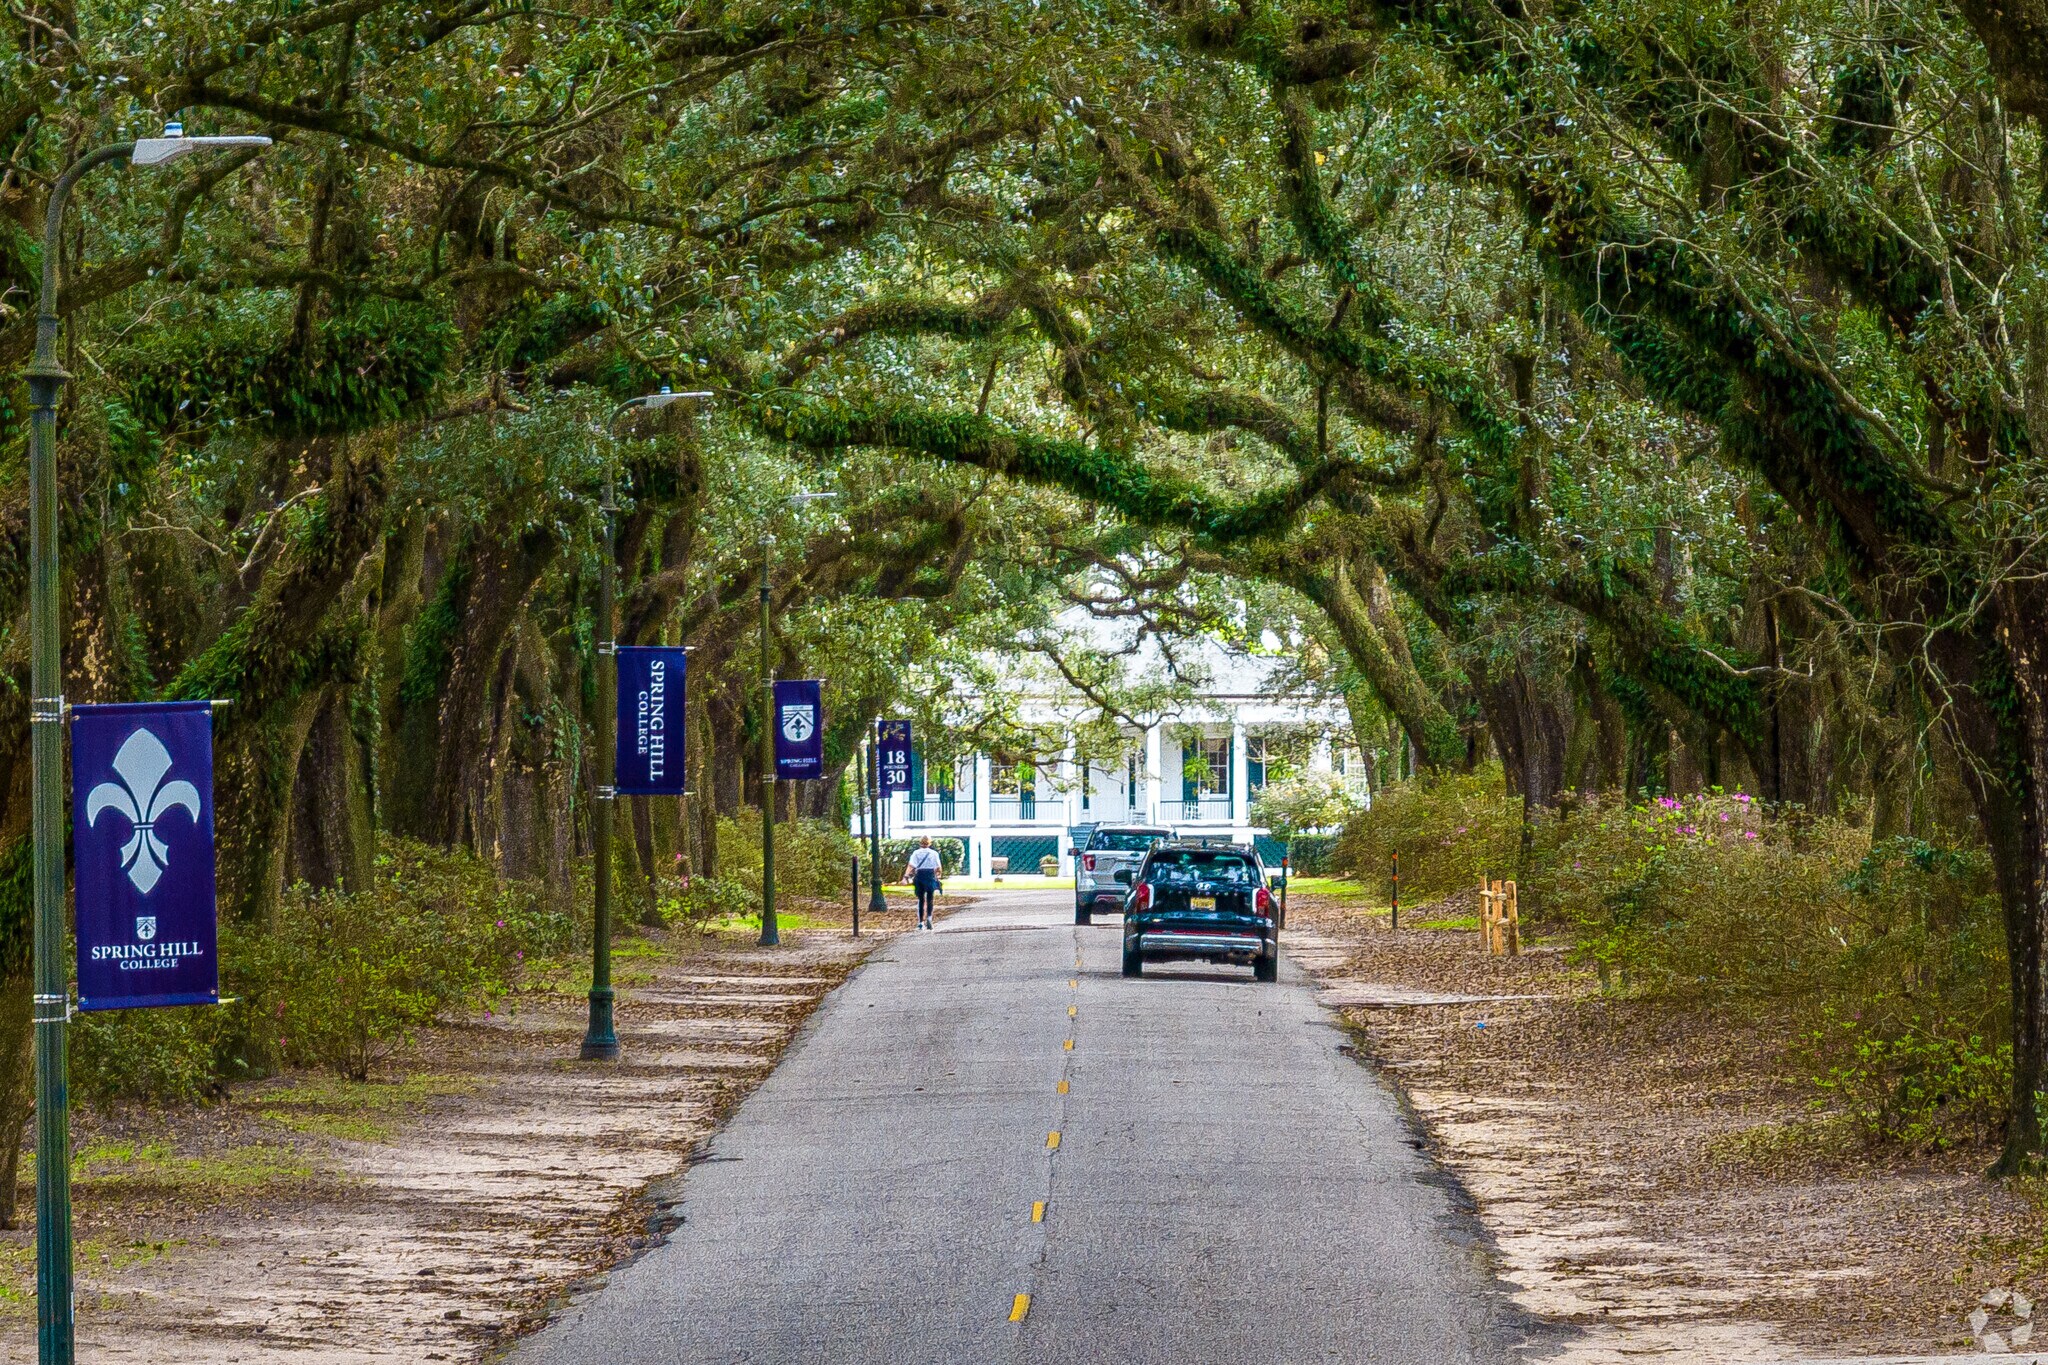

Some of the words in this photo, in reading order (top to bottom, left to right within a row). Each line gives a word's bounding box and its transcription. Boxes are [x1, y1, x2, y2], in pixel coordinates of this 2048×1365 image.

[650, 660, 664, 730] SPRING
[638, 691, 648, 754] COLLEGE
[650, 735, 664, 781] HILL
[887, 750, 905, 764] 18
[886, 770, 906, 785] 30
[91, 944, 156, 960] SPRING
[159, 941, 204, 956] HILL
[120, 958, 179, 970] COLLEGE
